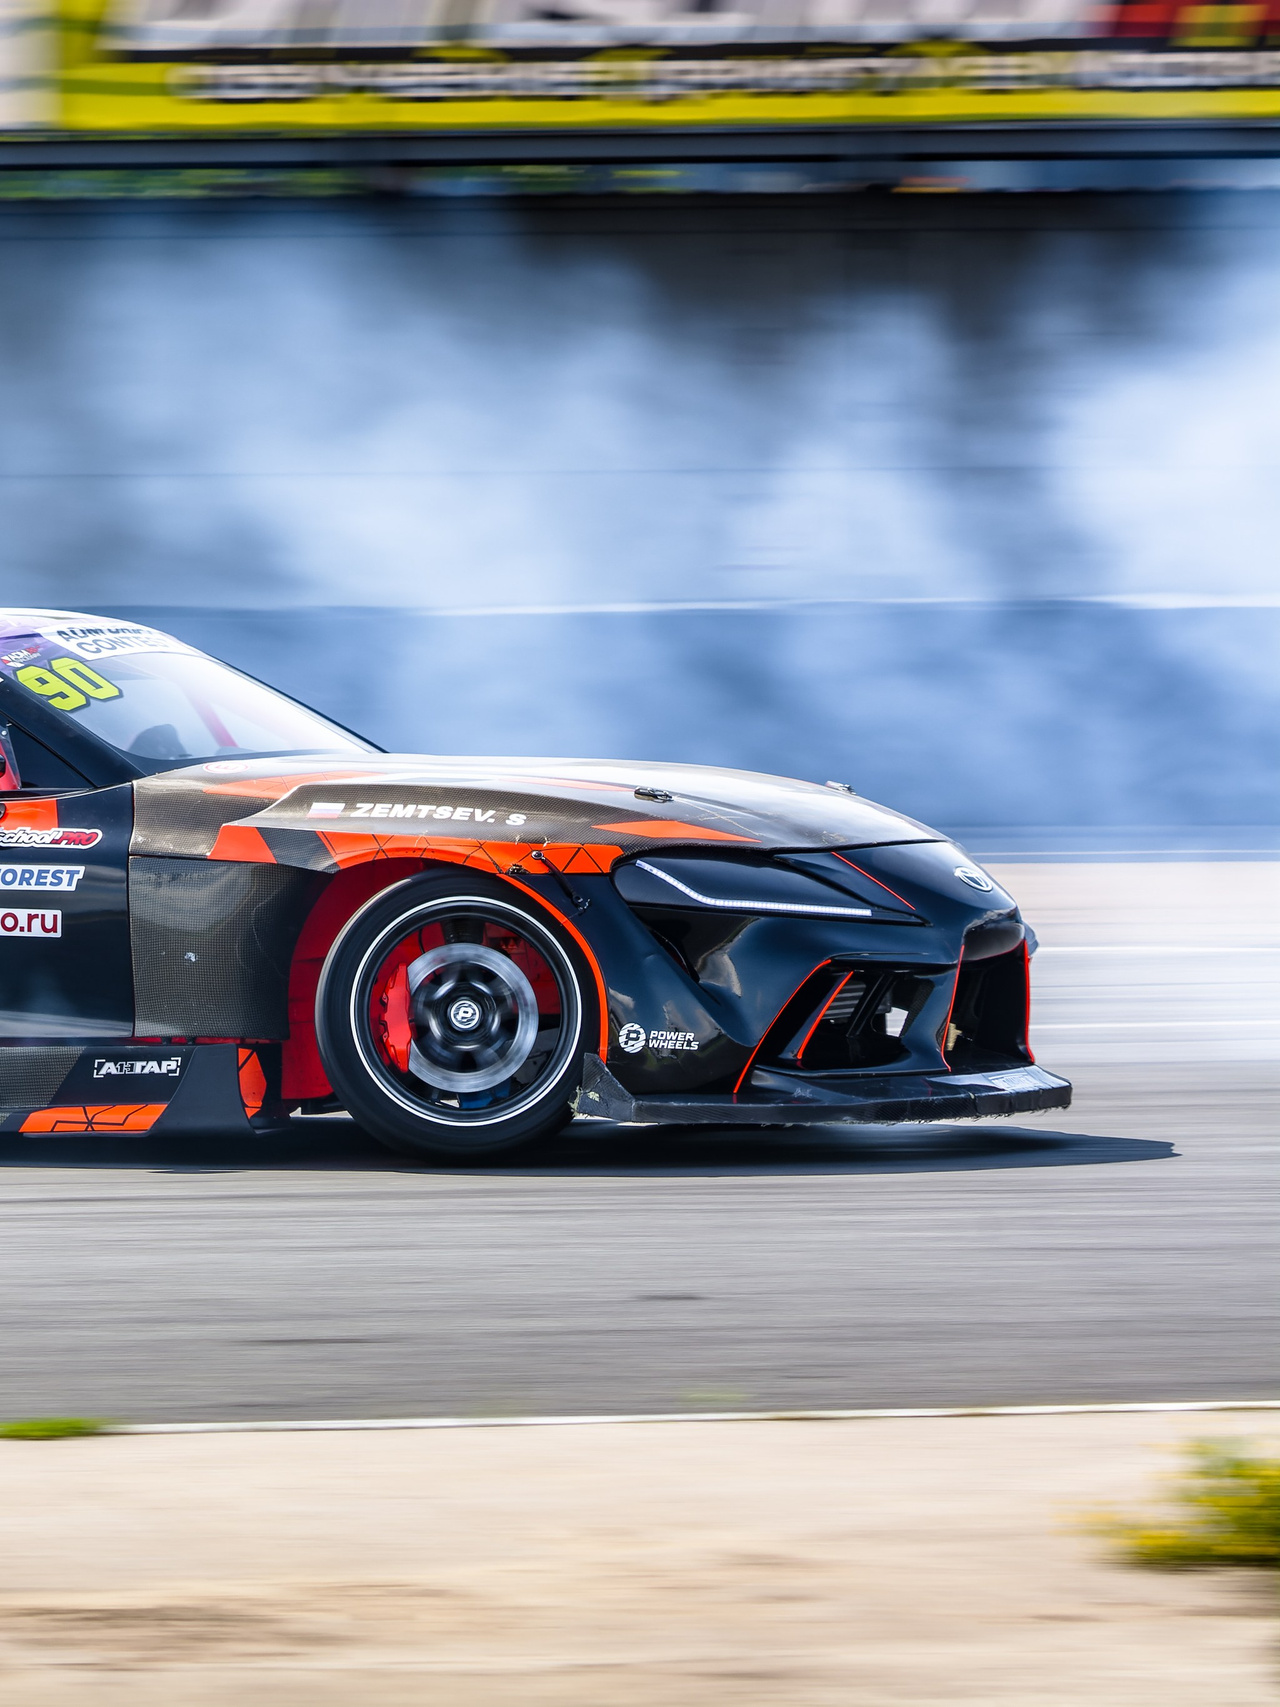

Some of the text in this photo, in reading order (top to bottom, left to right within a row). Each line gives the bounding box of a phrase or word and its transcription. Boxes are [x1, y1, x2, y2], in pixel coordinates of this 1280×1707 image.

[16, 657, 123, 712] 90
[350, 802, 528, 826] ZEMTSEV. S
[650, 1030, 695, 1041] POWER
[648, 1039, 700, 1051] WHEELS
